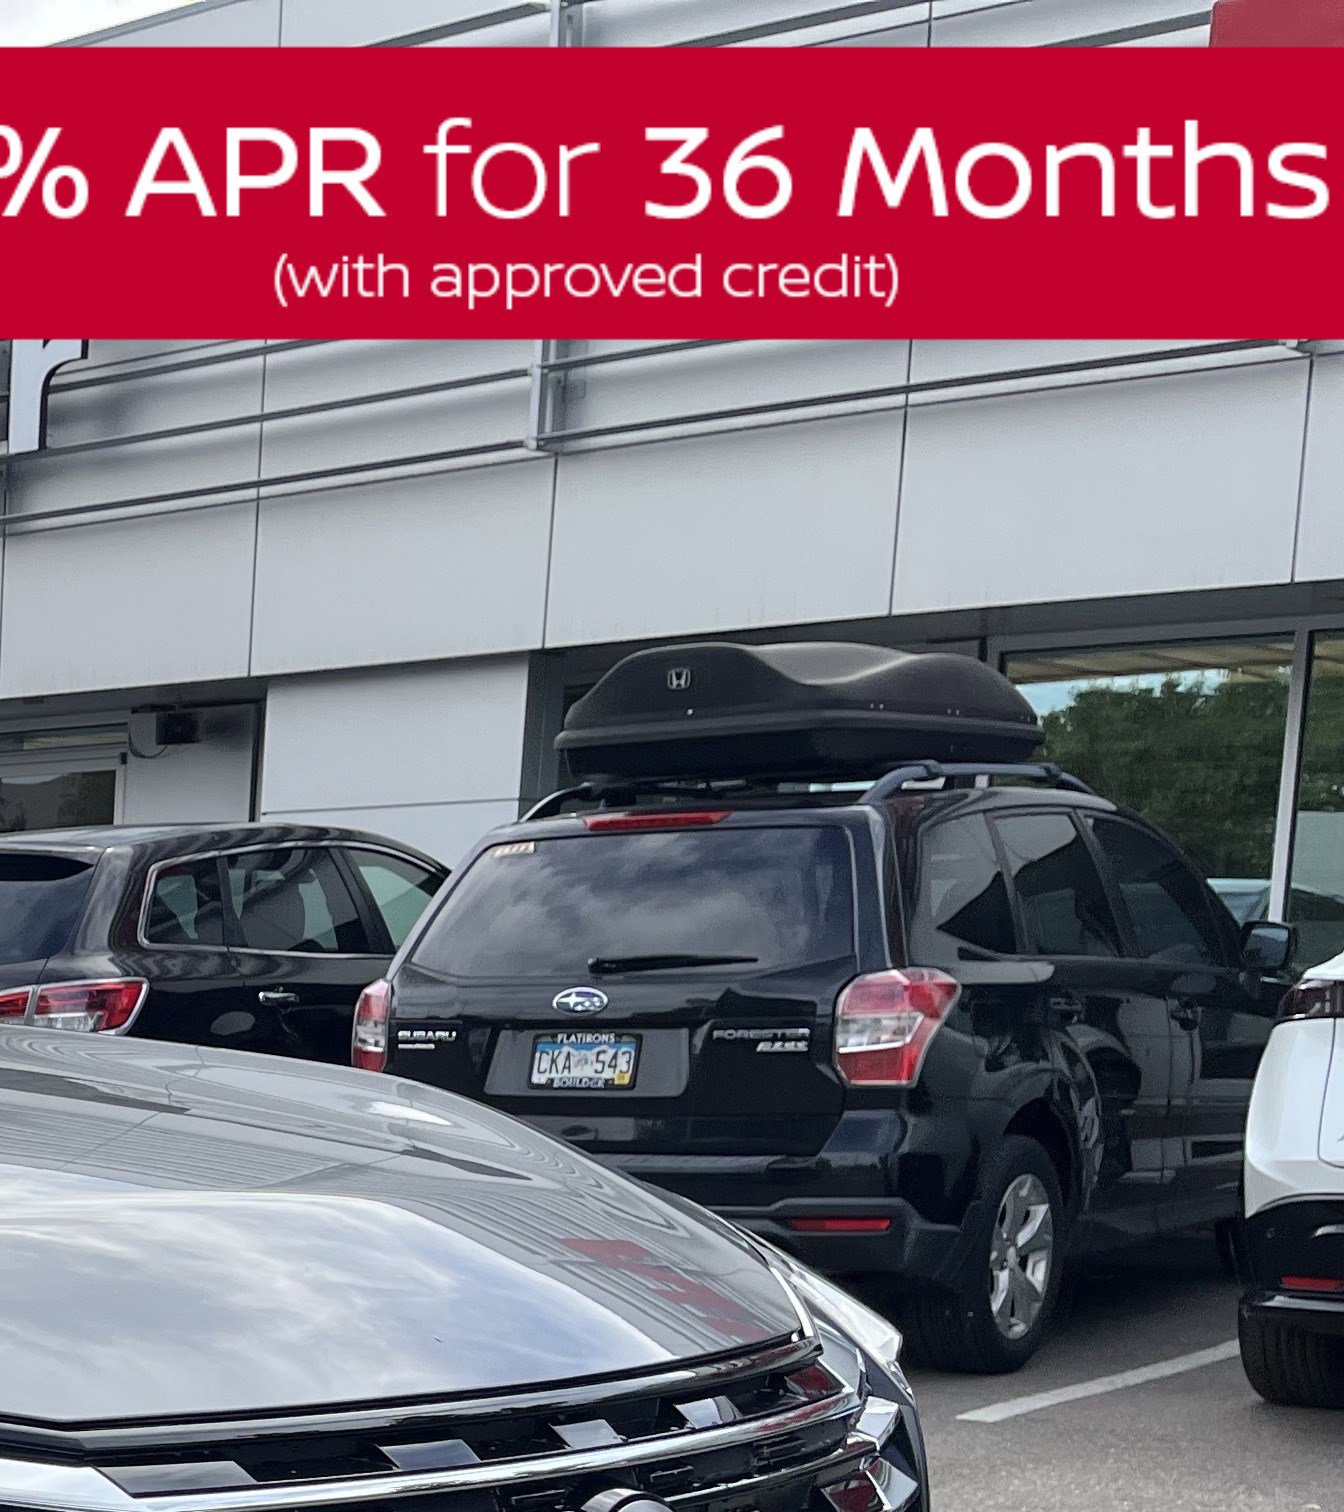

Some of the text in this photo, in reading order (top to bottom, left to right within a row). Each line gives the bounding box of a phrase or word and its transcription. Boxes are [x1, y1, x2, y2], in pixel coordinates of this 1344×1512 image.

[557, 1032, 616, 1045] FLATIRONS
[537, 1049, 633, 1075] CKA 543
